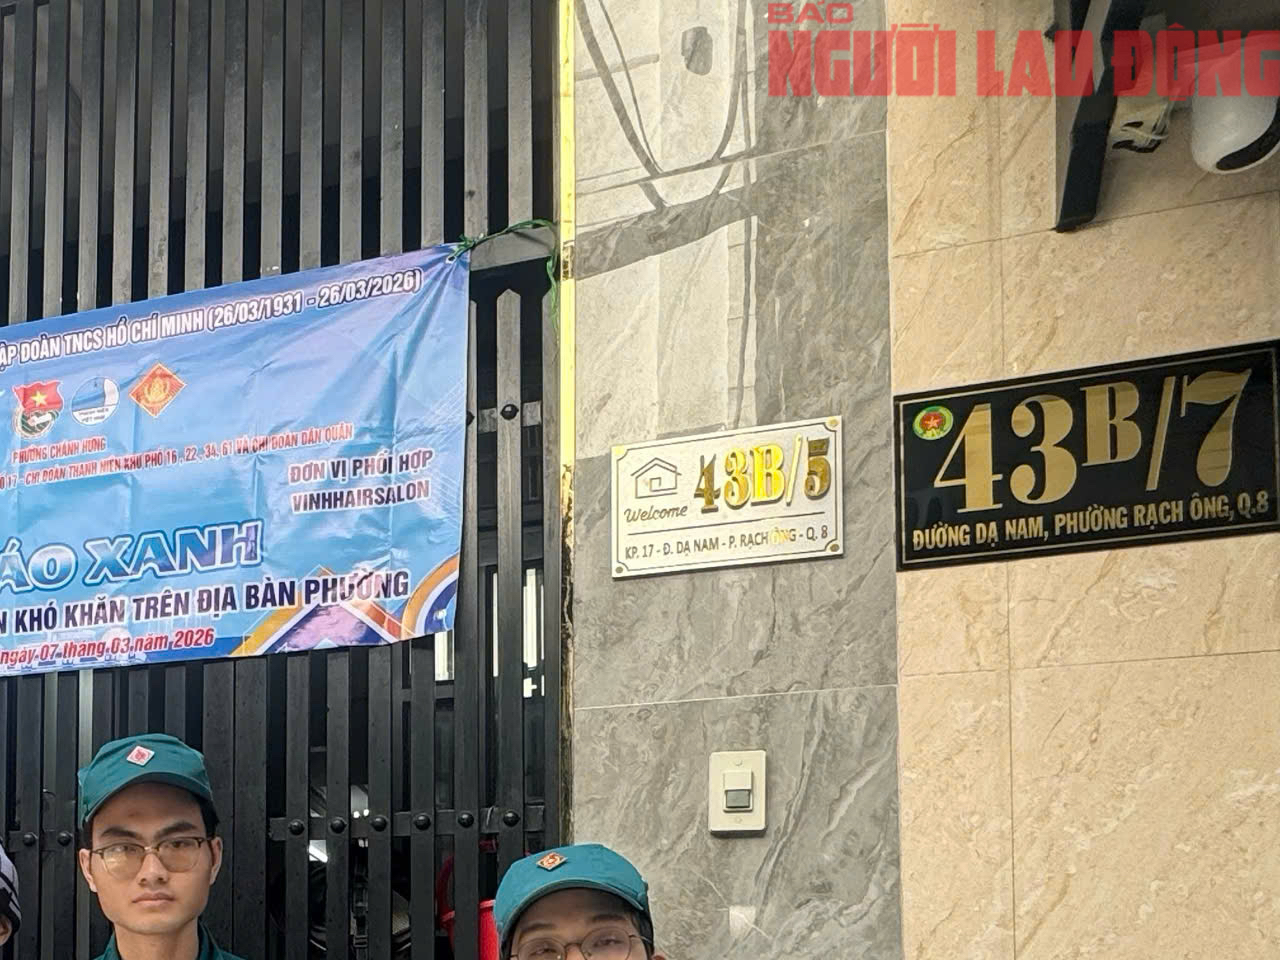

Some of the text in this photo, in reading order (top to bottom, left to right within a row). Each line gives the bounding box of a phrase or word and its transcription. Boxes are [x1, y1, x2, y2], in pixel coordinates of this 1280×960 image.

[20, 334, 61, 362] ĐOÀN
[64, 328, 104, 351] TNCS
[131, 313, 158, 343] CHÍ
[160, 309, 204, 338] MINH
[208, 291, 302, 331] (26/03/1931
[319, 269, 422, 307] 26/03/2026)
[290, 450, 433, 483] ĐƠN VỊ PHỐI HỢP
[934, 369, 1252, 513] 43B/7
[292, 480, 429, 512] VINHHAIRSALON
[694, 433, 832, 514] 43B/5
[624, 505, 688, 523] Welcome
[625, 546, 639, 560] KP.
[642, 544, 654, 556] 17
[677, 541, 690, 557] DẠ
[694, 537, 719, 553] NAM
[729, 535, 738, 548] P.
[740, 531, 769, 551] RẠCH
[806, 527, 818, 541] Q.
[821, 525, 829, 539] 8
[912, 490, 1270, 551] ĐƯỜNG DẠ NAM, PHƯỜNG RẠCH ÔNG, Q.8
[84, 519, 265, 585] XANH
[16, 602, 57, 633] KHÓ
[64, 595, 125, 628] KHĂN
[133, 588, 190, 621] TRÊN
[197, 584, 233, 618] ĐỊA
[246, 575, 296, 610] BÀN
[305, 570, 409, 605] PHƯỜNG
[0, 649, 36, 667] ngày
[40, 643, 59, 661] 07
[64, 640, 105, 658] tháng
[111, 636, 130, 654] 03
[134, 632, 168, 652] năm
[173, 628, 215, 648] 2026
